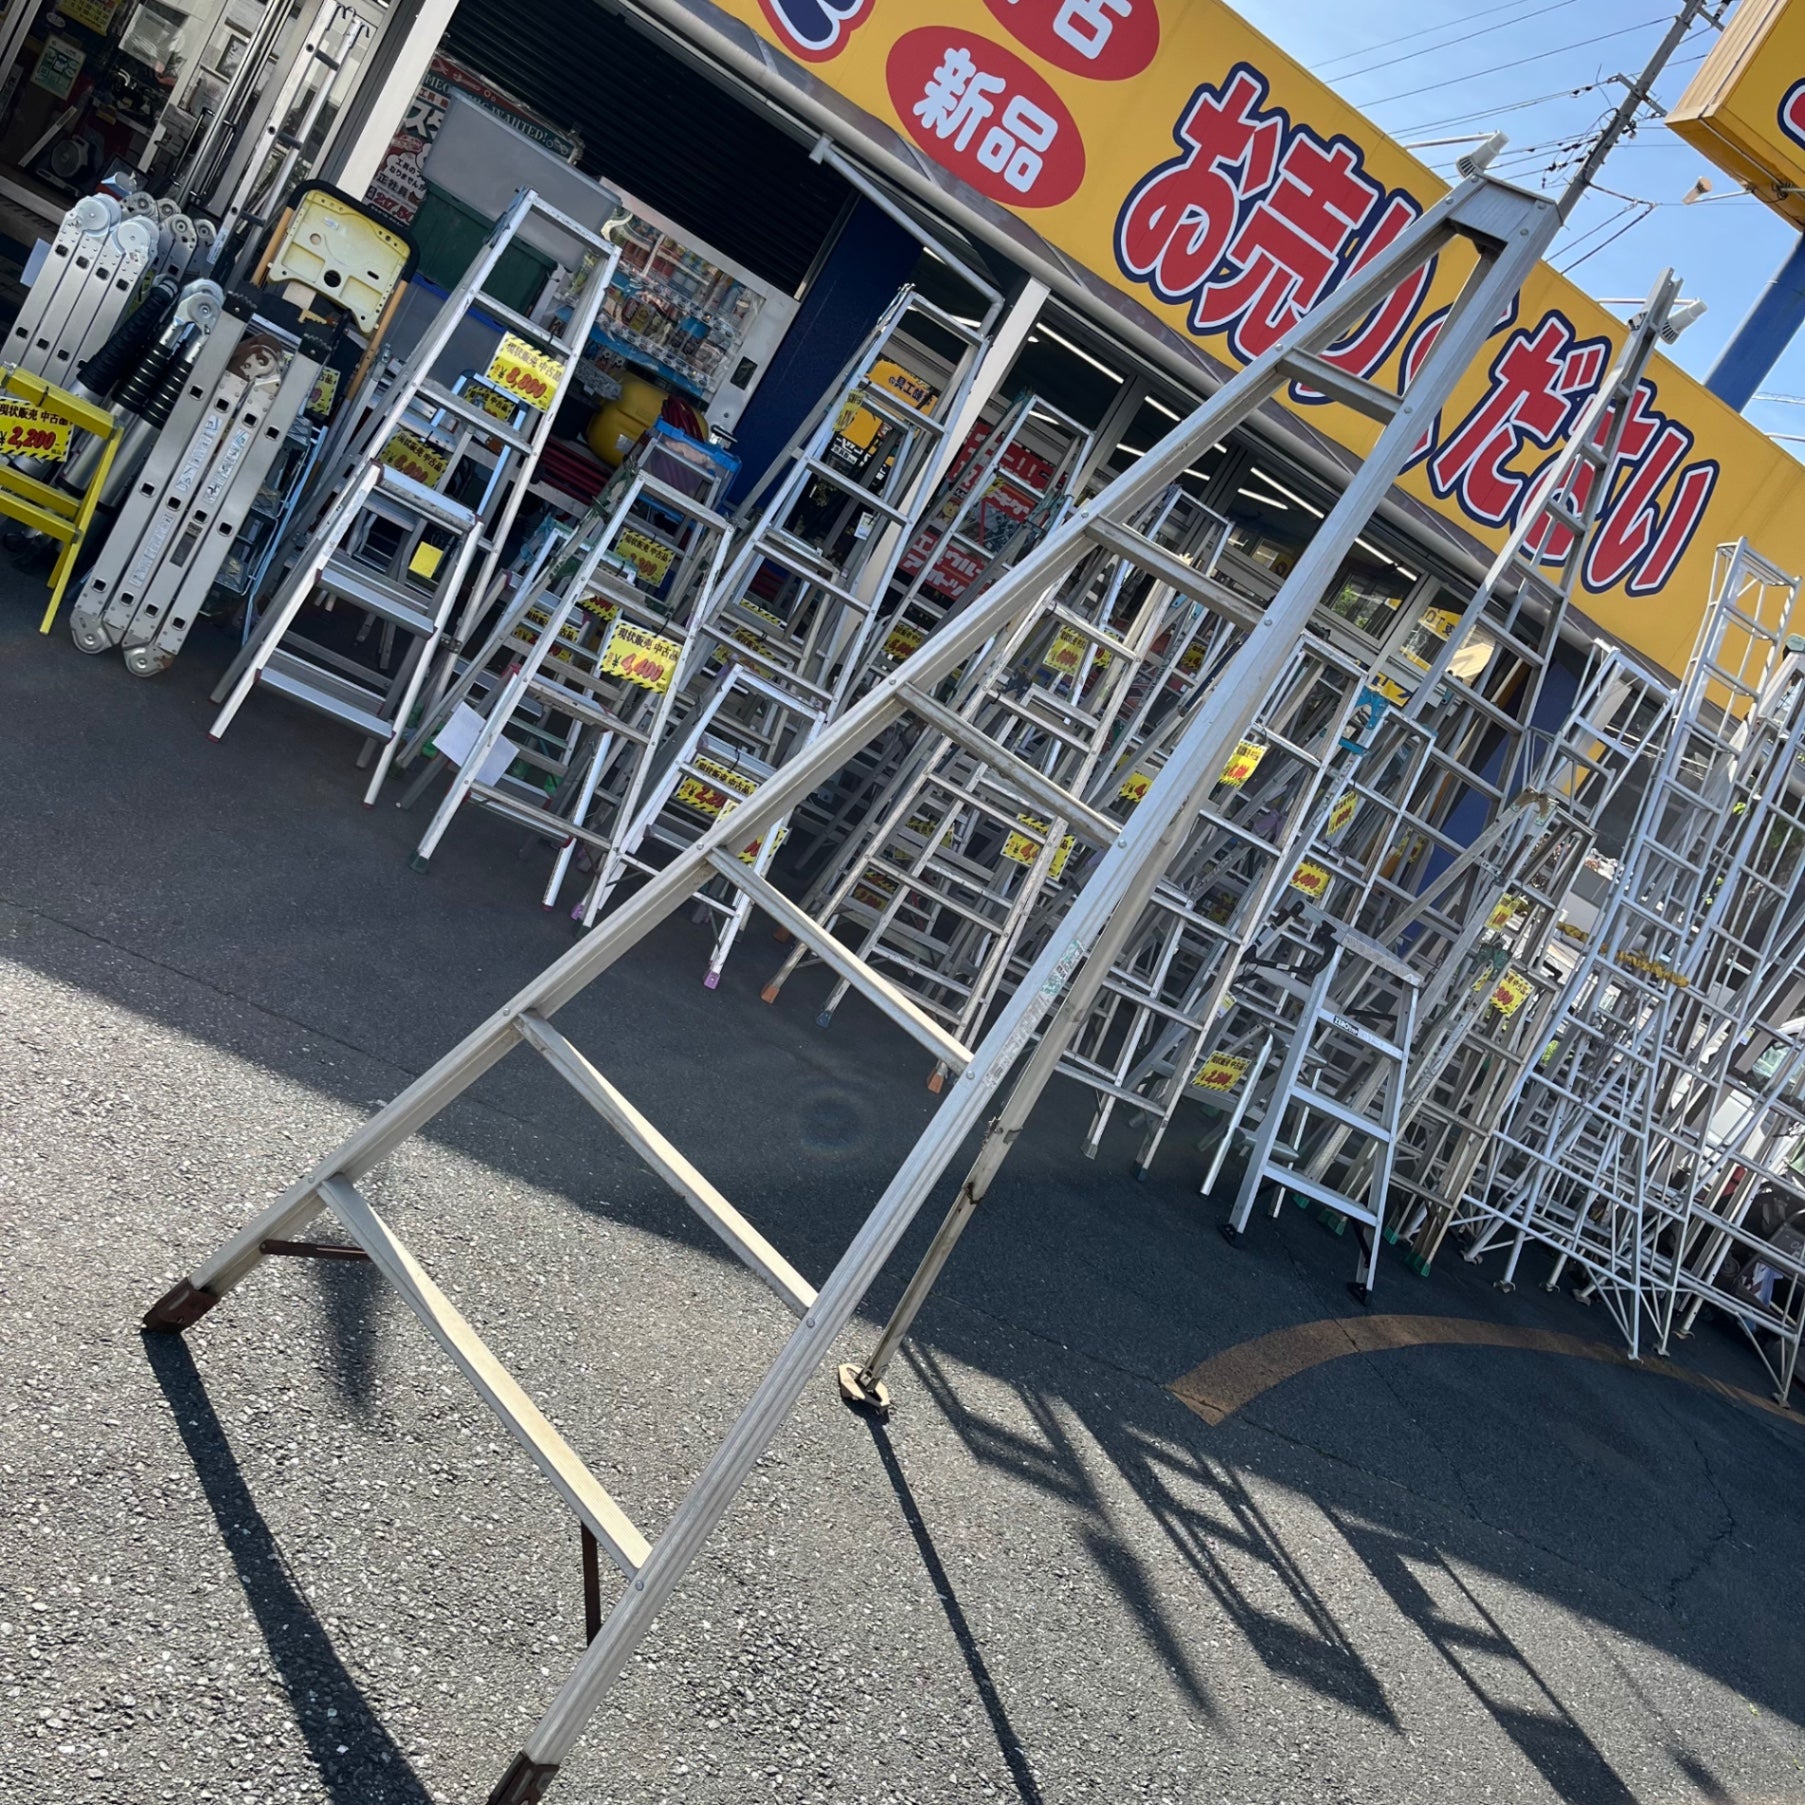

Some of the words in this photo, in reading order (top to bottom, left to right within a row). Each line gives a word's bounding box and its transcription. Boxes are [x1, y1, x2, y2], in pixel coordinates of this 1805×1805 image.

[912, 46, 1059, 193] 新品
[539, 361, 562, 382] 中古品
[41, 411, 68, 426] 中古品
[618, 627, 652, 650] 現状販売
[653, 643, 678, 661] 中古品
